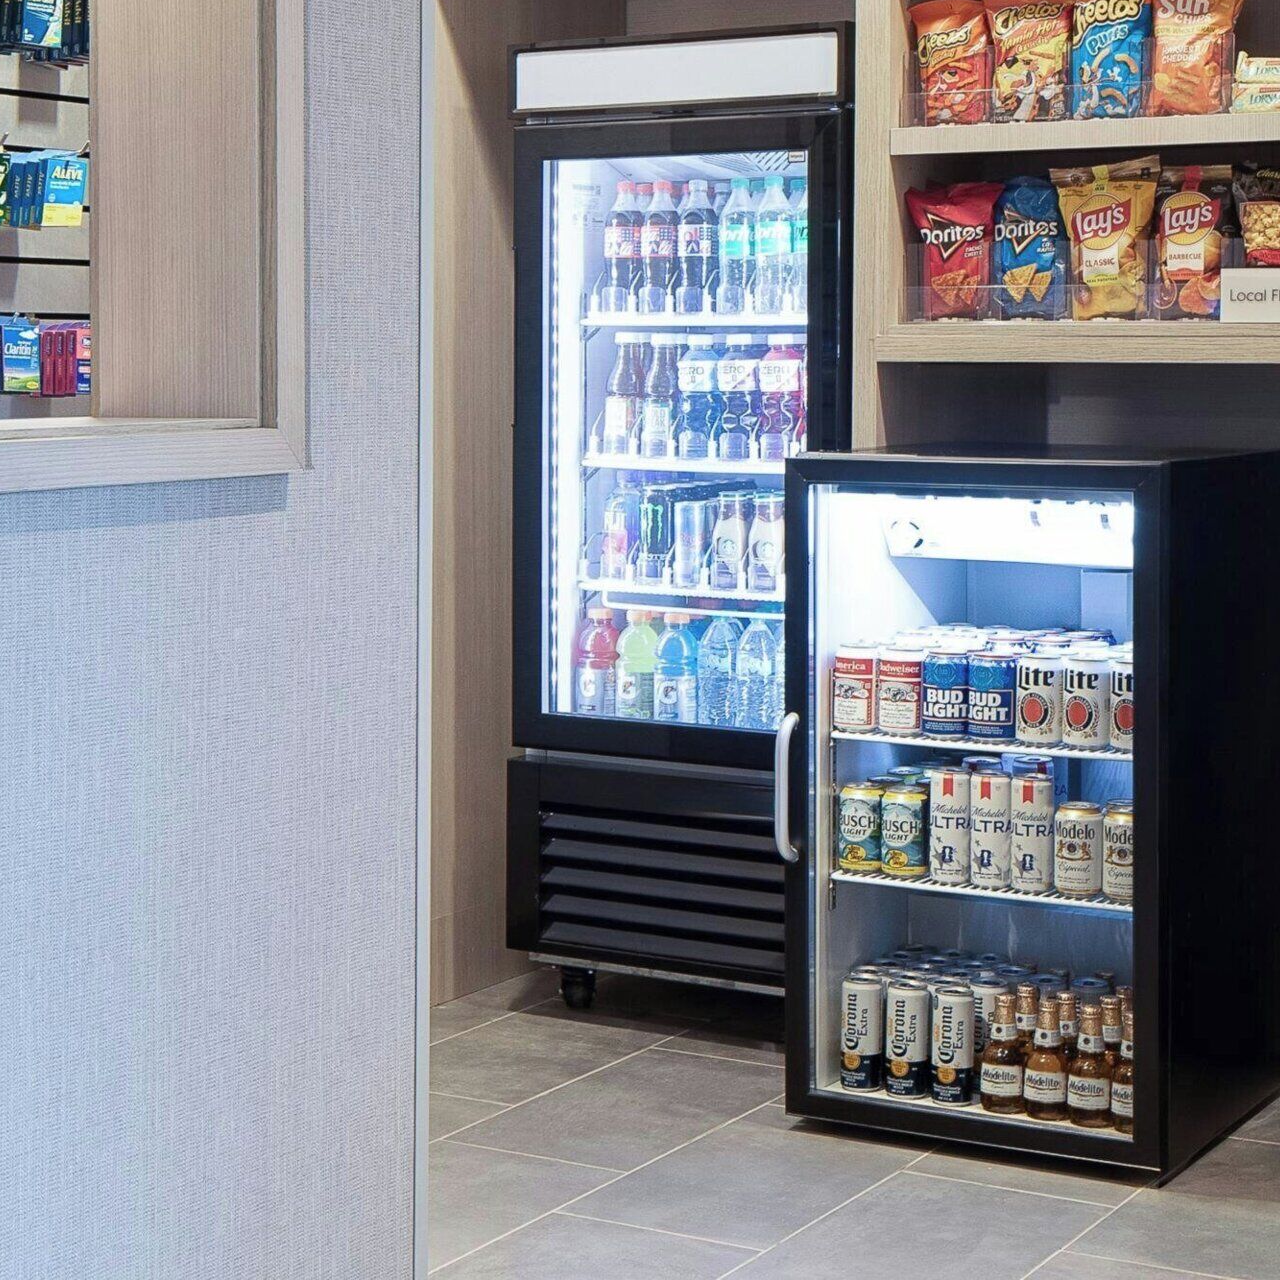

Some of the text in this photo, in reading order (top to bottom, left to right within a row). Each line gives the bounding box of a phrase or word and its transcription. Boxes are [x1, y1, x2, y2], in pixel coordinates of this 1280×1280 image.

[995, 2, 1064, 36] Cheetos
[52, 165, 84, 181] ALEVE
[1076, 203, 1125, 240] Lay's
[1164, 202, 1214, 236] Lay's
[920, 224, 984, 245] Doritos
[995, 221, 1058, 242] Doritos
[1084, 257, 1115, 267] CLASSIC
[1168, 253, 1202, 261] BARBECUE
[1229, 289, 1266, 302] Local
[4, 343, 31, 355] Claritin
[836, 659, 866, 670] merica
[1019, 665, 1054, 691] Lite
[1065, 668, 1099, 694] Lite
[1112, 670, 1133, 697] Lit
[927, 688, 964, 703] BUD
[968, 692, 1002, 707] BUD
[923, 702, 969, 718] LIGHT
[968, 703, 1009, 721] IGHT
[971, 806, 1007, 818] Michelob
[1012, 810, 1048, 822] Michelob
[843, 828, 867, 836] LIGHT
[885, 833, 909, 841] LIGHT
[1105, 825, 1133, 844] Mode
[844, 992, 859, 1051] Corona
[857, 1008, 869, 1038] Extra
[892, 999, 908, 1058] Corona
[906, 1014, 917, 1044] Extra
[938, 1005, 955, 1064] Corona
[953, 1021, 964, 1051] Extra
[1069, 1079, 1104, 1094] Modelitos
[1112, 1087, 1133, 1100] Model
